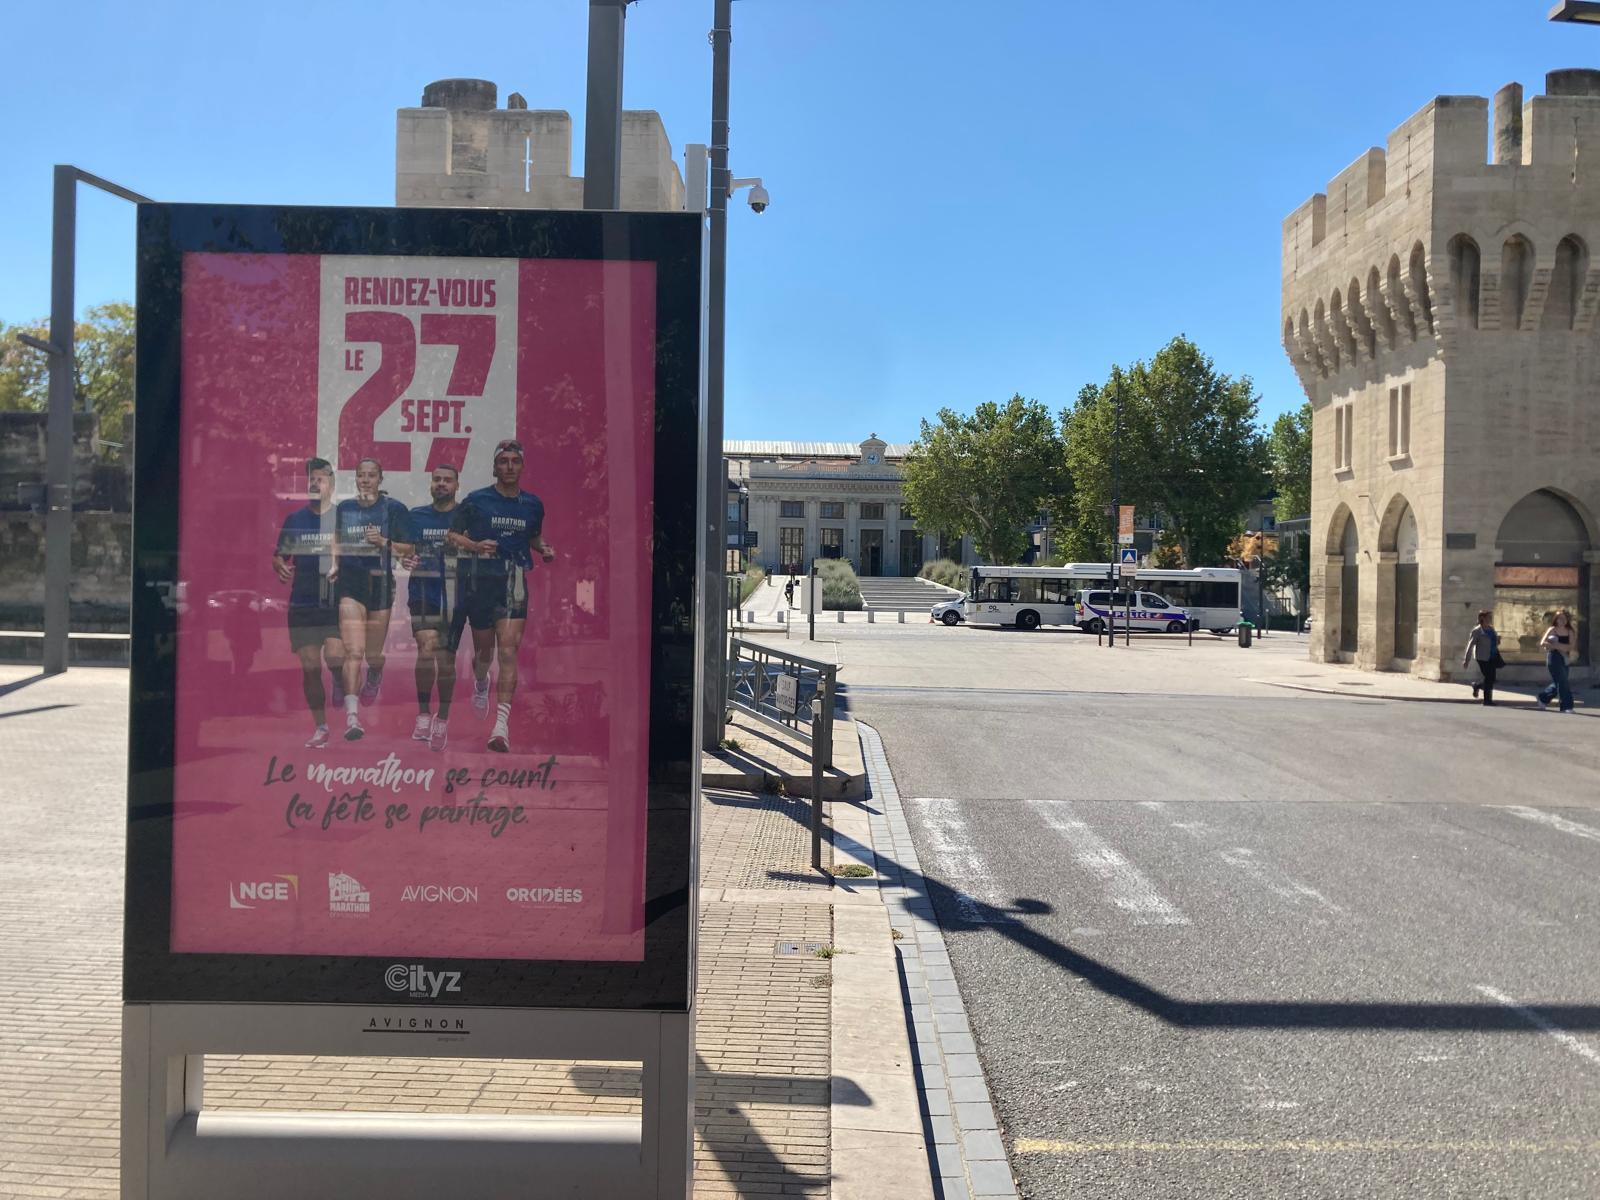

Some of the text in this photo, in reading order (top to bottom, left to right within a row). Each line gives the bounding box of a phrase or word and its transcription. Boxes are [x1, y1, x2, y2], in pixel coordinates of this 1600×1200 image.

[344, 277, 496, 307] RENDEZ-VOUS
[344, 350, 364, 371] LE
[337, 311, 497, 473] 27
[400, 399, 472, 433] SEPT.
[263, 751, 557, 793] Le marathon se court,
[285, 793, 315, 829] la
[321, 788, 376, 831] fête
[384, 803, 410, 829] se
[239, 882, 289, 900] NGE
[400, 885, 479, 904] AVIGNON
[384, 964, 462, 998] Cityz
[369, 1017, 464, 1029] AVIGNON
